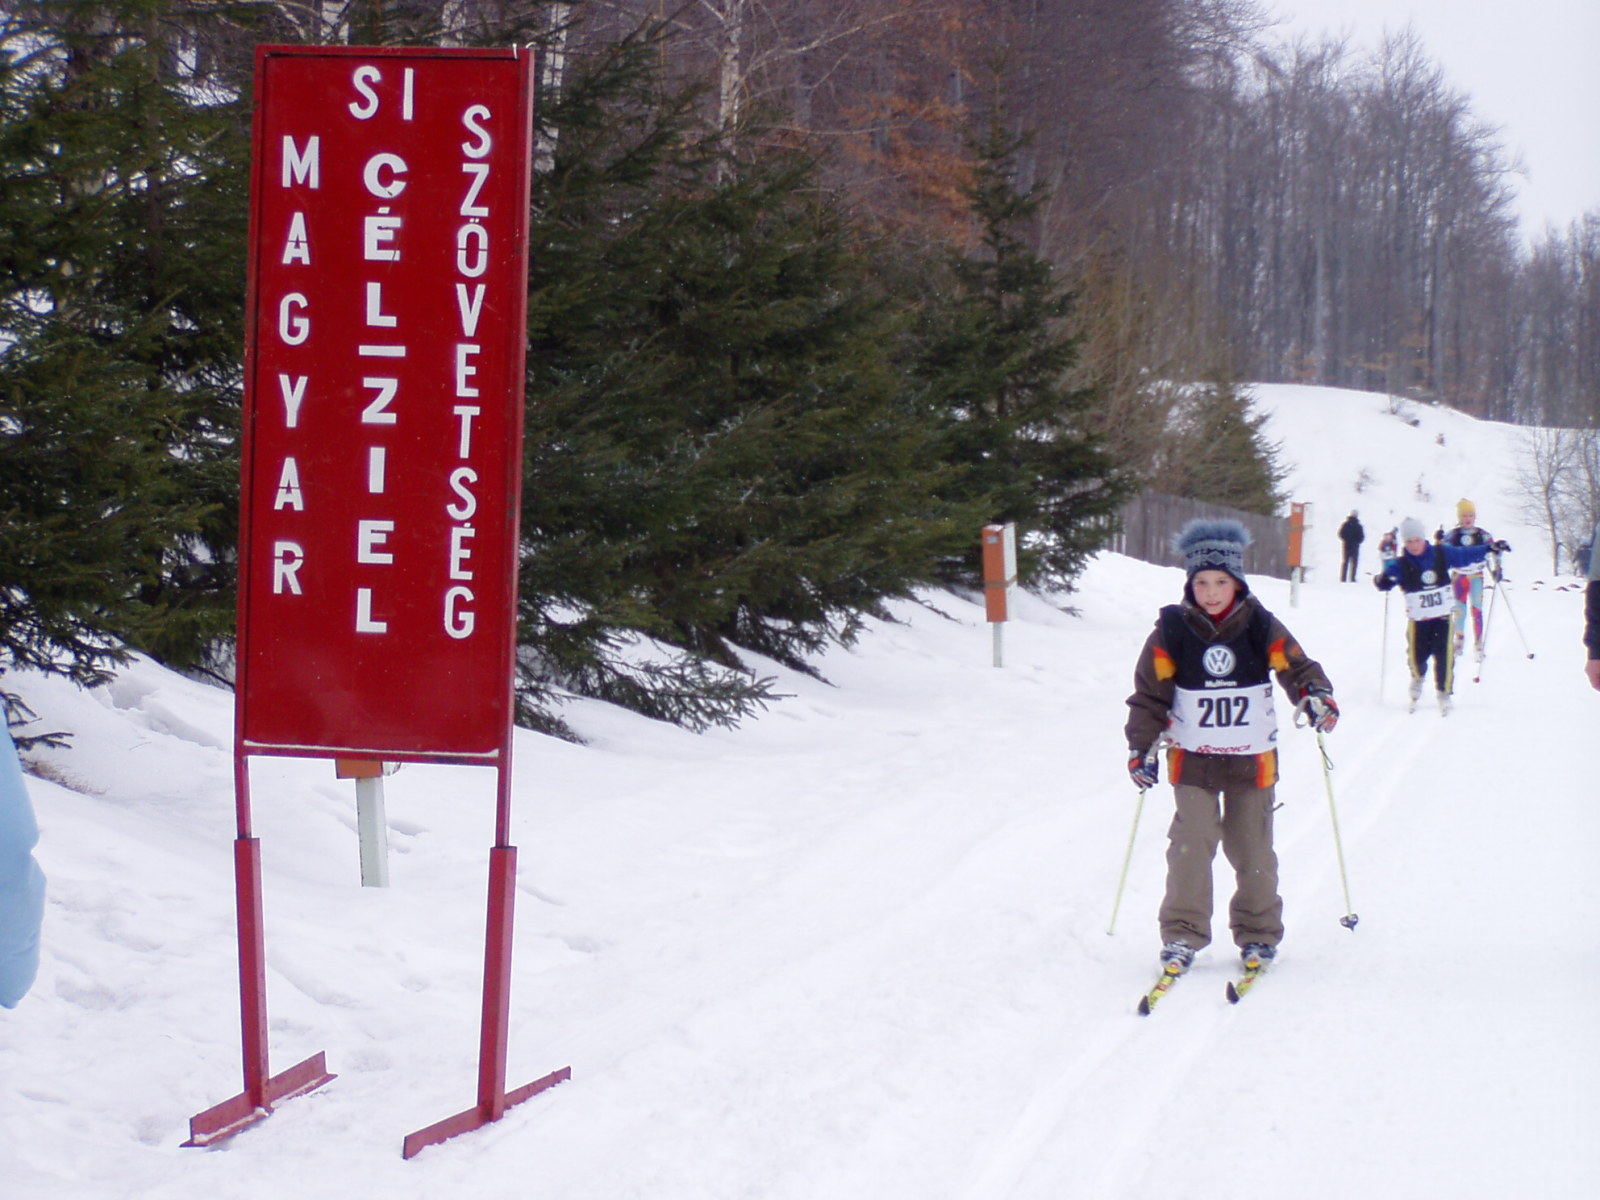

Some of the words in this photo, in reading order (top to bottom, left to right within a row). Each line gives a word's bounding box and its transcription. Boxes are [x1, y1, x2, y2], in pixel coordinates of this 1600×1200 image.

[348, 65, 415, 121] SI
[273, 135, 320, 596] MAGYAR
[444, 104, 492, 640] SZÖVETSÉG
[1419, 592, 1442, 608] 203
[1198, 696, 1249, 728] 202
